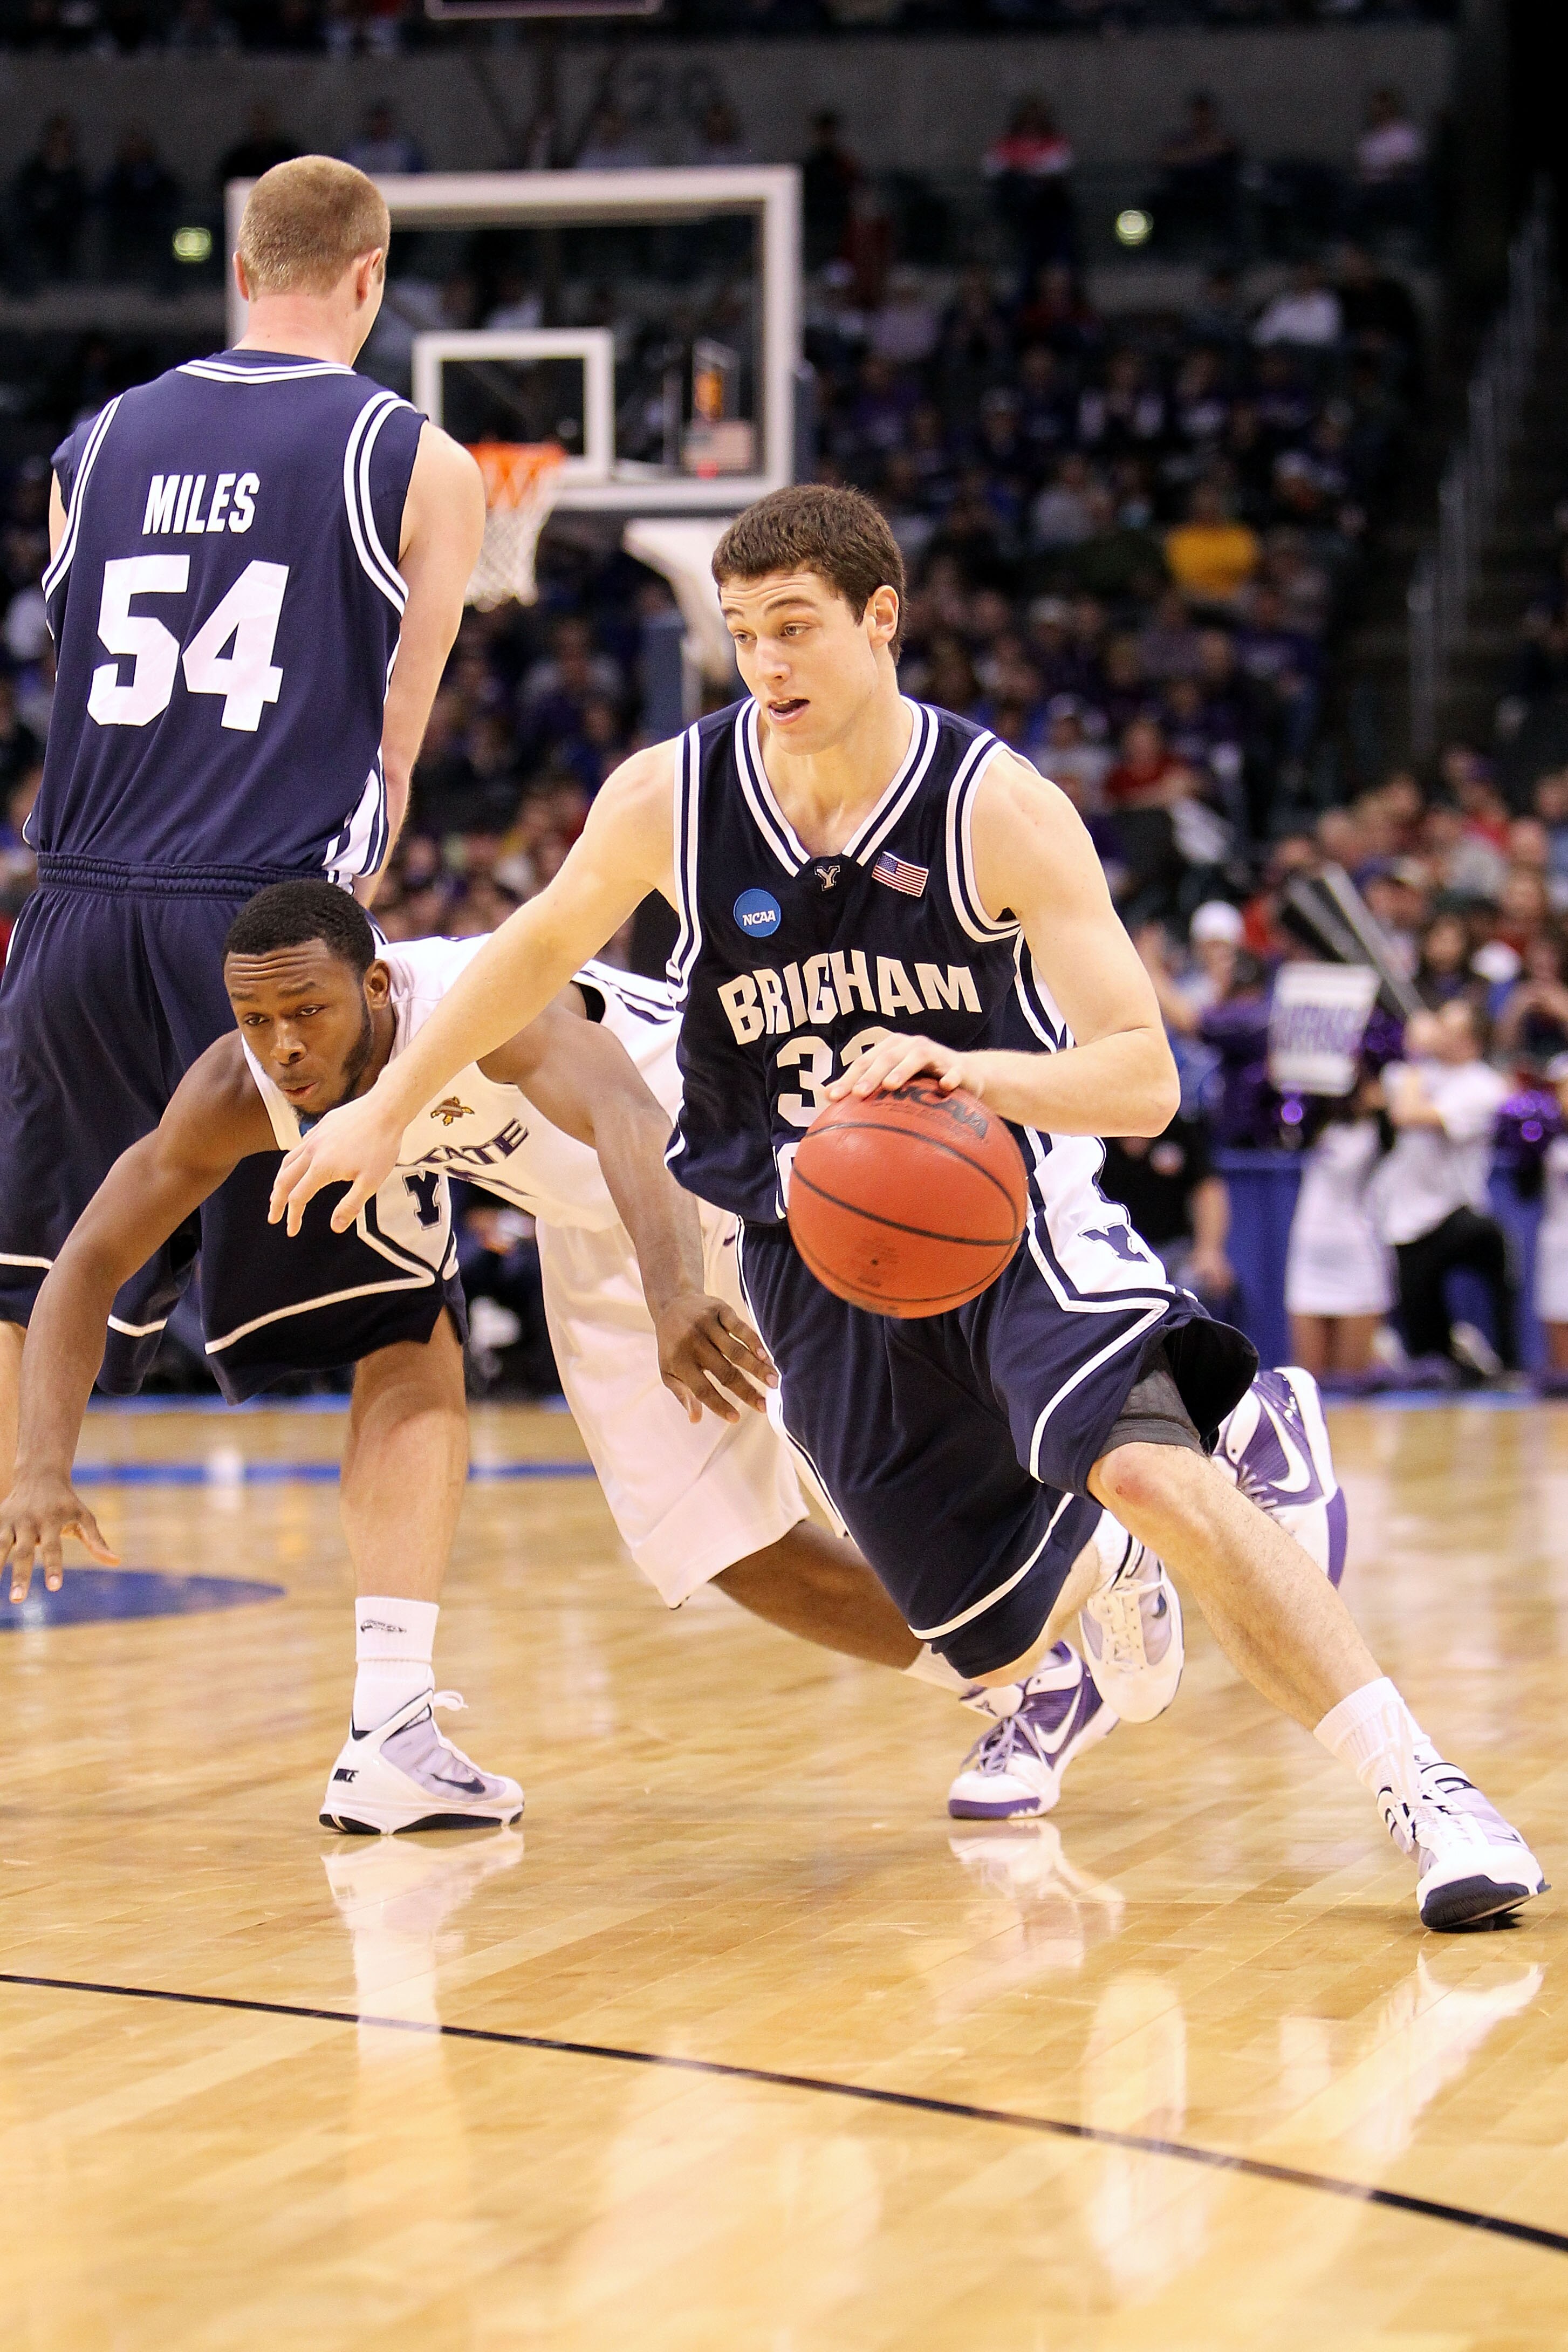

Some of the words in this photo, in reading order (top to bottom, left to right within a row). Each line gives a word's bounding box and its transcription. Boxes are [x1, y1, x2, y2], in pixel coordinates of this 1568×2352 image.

[142, 472, 261, 535] MILES
[87, 553, 290, 732] 54
[814, 865, 840, 892] Y
[742, 910, 776, 926] NCAA
[717, 949, 982, 1045] BRIGHAM
[402, 1170, 442, 1231] Y
